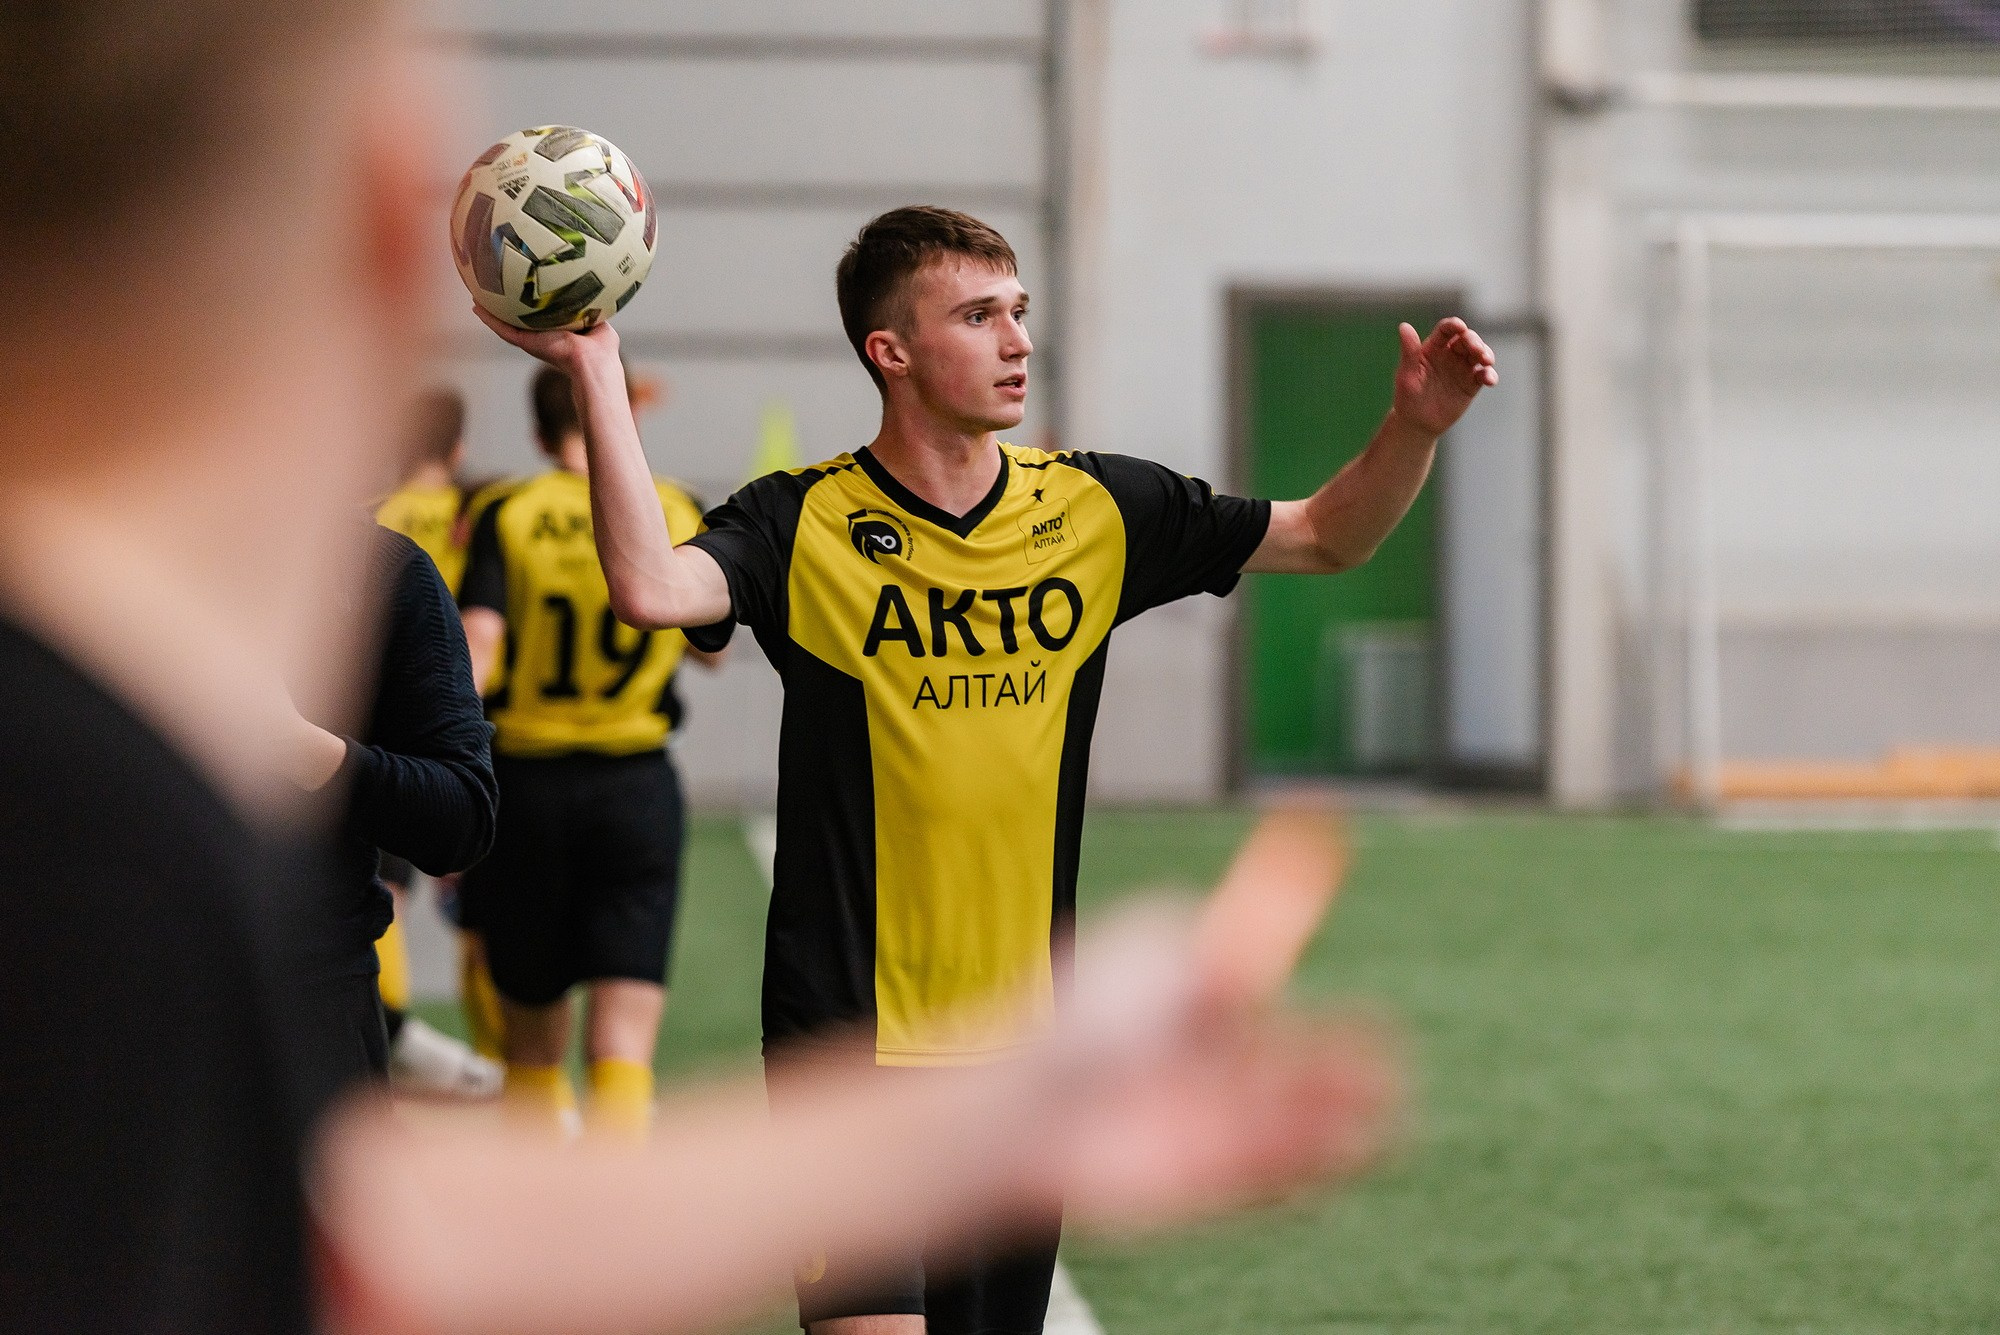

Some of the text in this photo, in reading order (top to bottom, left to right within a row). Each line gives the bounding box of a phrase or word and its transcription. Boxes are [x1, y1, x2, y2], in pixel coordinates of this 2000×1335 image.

[1033, 532, 1066, 550] АЛТАЙ
[540, 593, 650, 699] 19
[862, 577, 1083, 658] АКТО
[912, 660, 1046, 709] АЛТАЙ
